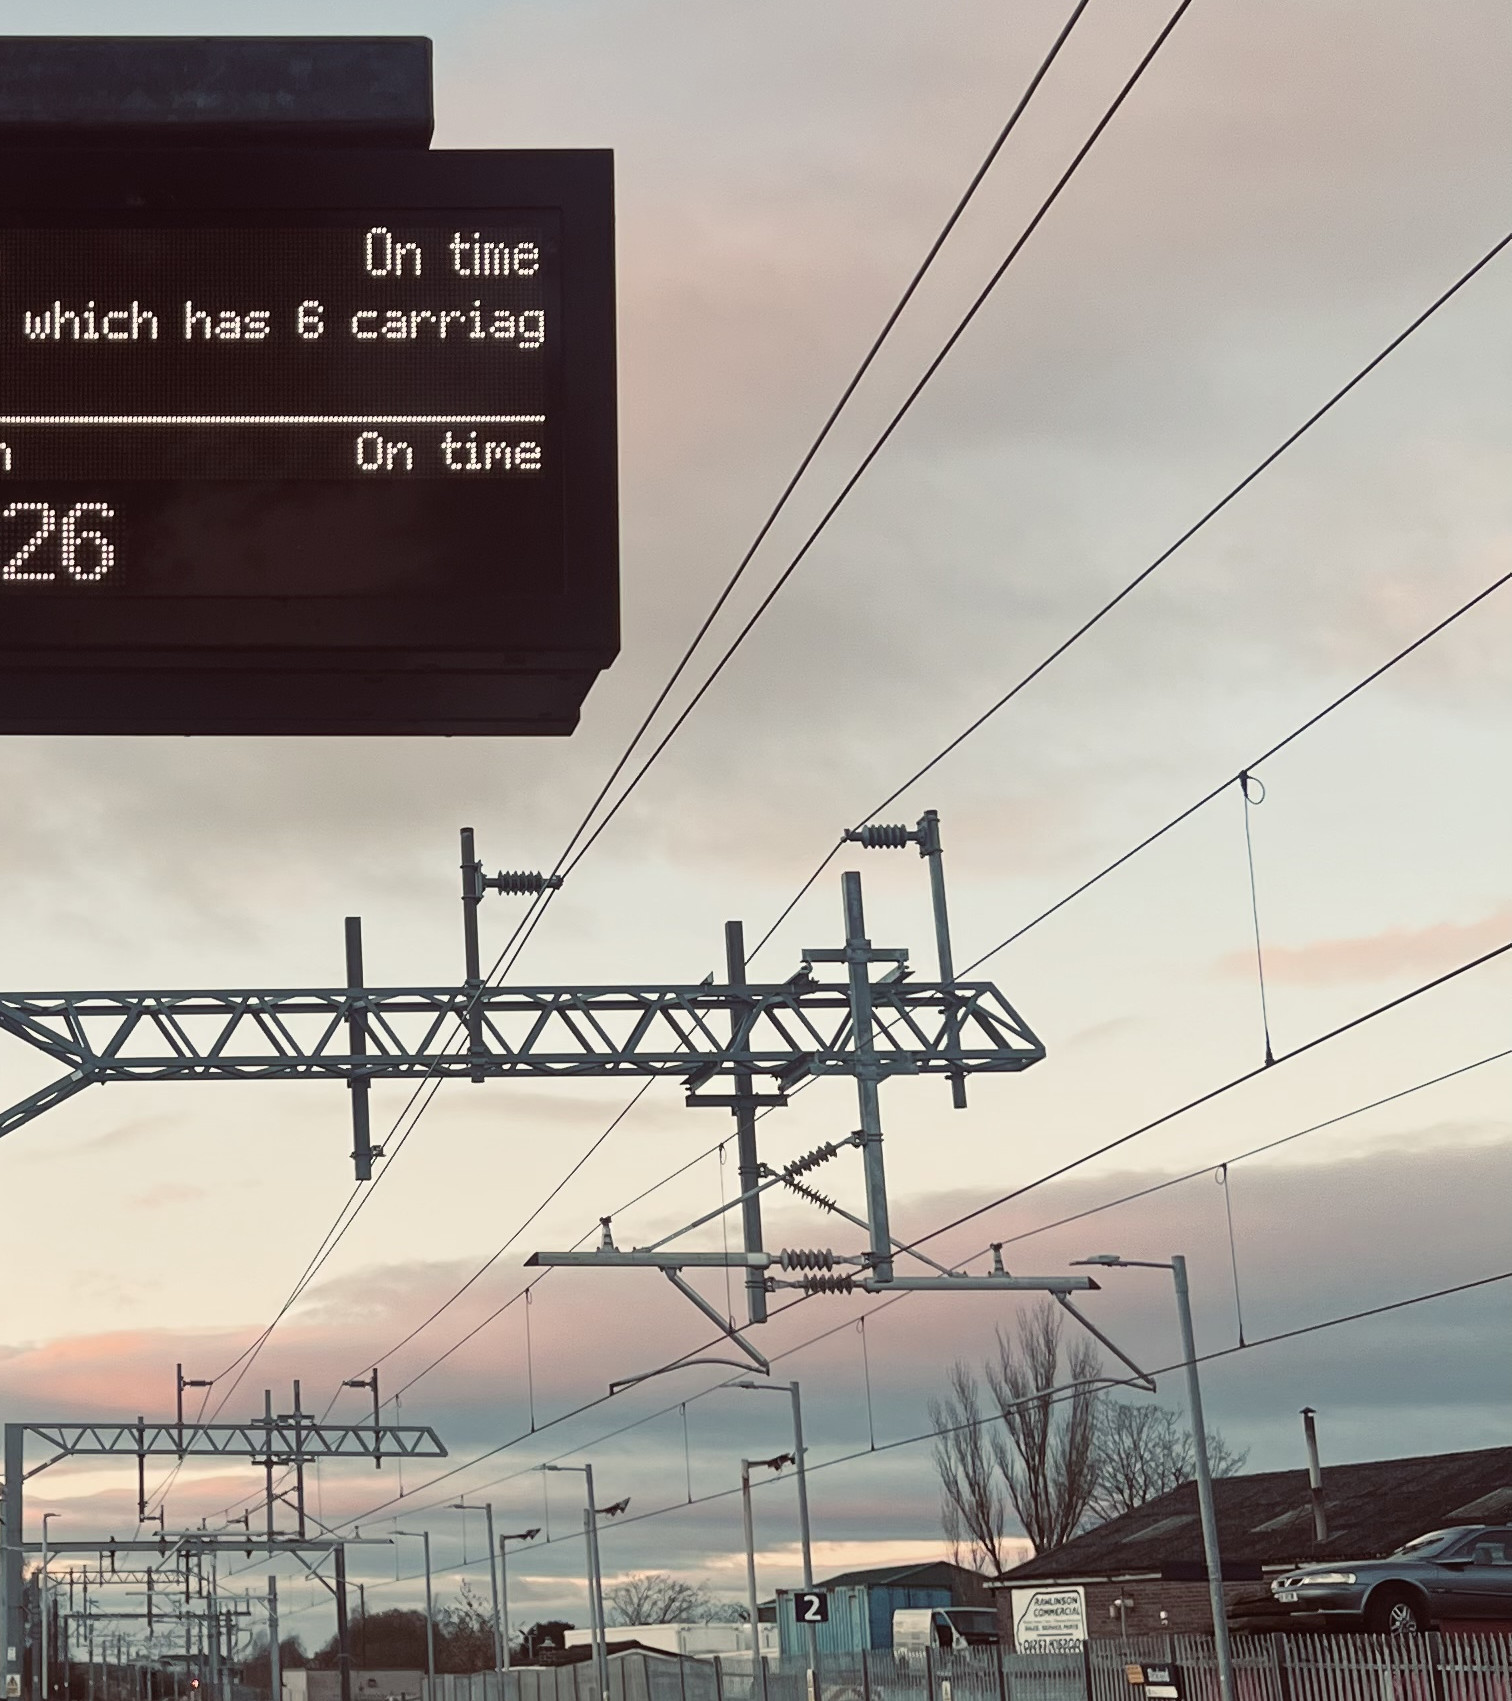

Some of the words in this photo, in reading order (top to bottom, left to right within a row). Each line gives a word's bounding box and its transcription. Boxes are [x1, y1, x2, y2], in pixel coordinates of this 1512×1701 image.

[366, 226, 422, 277] On
[449, 231, 540, 276] time
[24, 300, 158, 340] which
[185, 300, 271, 340] has
[297, 299, 325, 340] 6
[351, 299, 545, 349] carriag
[356, 430, 413, 471] On
[440, 430, 542, 471] time
[803, 1594, 821, 1621] 2
[1033, 1607, 1080, 1617] COMMERCIAL
